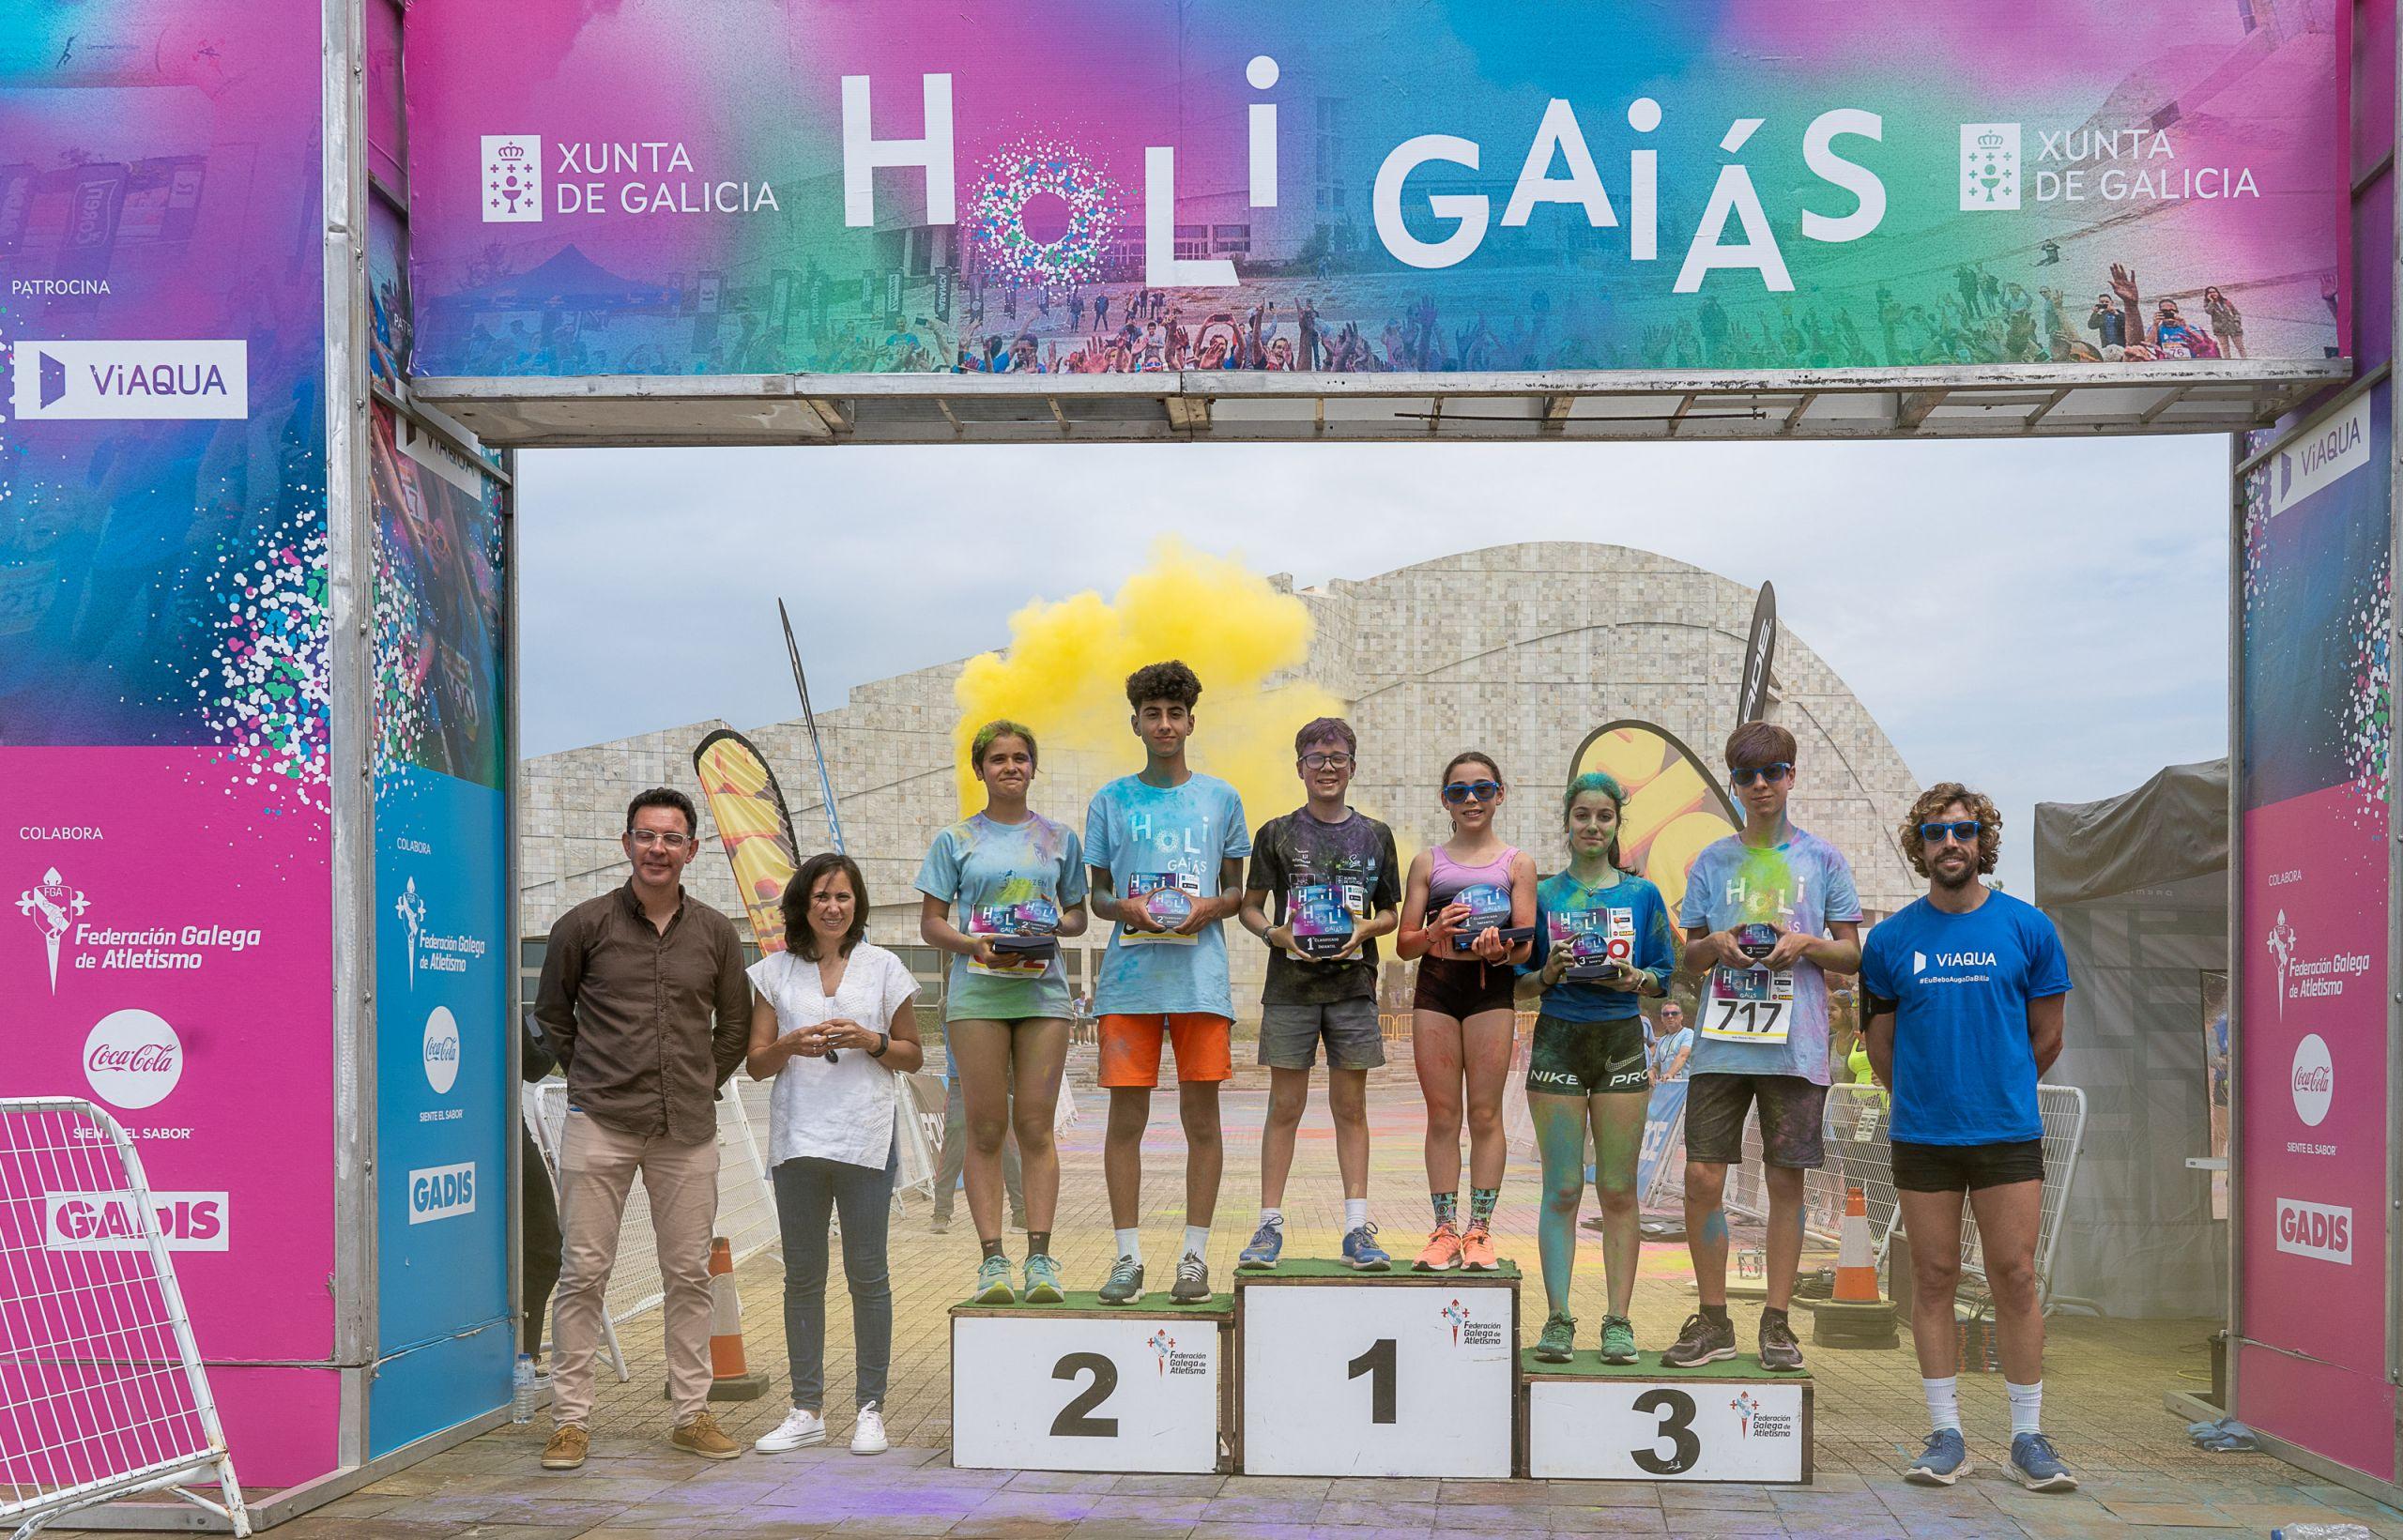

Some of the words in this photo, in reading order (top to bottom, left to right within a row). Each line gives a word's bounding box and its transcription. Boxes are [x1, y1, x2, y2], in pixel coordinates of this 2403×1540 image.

[2036, 128, 2174, 162] XUNTA
[557, 142, 694, 174] XUNTA
[2036, 169, 2085, 202] DE
[2101, 167, 2259, 200] GALICIA
[557, 185, 605, 215] DE
[621, 180, 780, 214] GALICIA
[12, 280, 111, 295] PATROCINA
[20, 827, 104, 840] COLABORA
[397, 837, 432, 855] COLABORA
[2268, 869, 2303, 887] COLABORA
[44, 887, 63, 898] FGA
[75, 923, 176, 946] Federación
[181, 924, 262, 952] Galega
[420, 929, 457, 952] Federación
[458, 935, 485, 958] Galega
[75, 953, 97, 969] de
[101, 949, 203, 969] Atletismo
[420, 955, 428, 969] de
[430, 953, 466, 972] Atletismo
[2289, 957, 2332, 977] Federación
[2333, 952, 2370, 976] Galega
[2288, 984, 2298, 999] de
[2300, 979, 2343, 998] Atletismo
[1717, 1000, 1783, 1033] 717
[1530, 1069, 1579, 1085] NIKE
[1609, 1069, 1648, 1087] PRO
[420, 1111, 438, 1122] SIENTE
[438, 1110, 446, 1121] EL
[2287, 1141, 2306, 1154] SIENTE
[2306, 1144, 2315, 1154] EL
[413, 1169, 473, 1213] GADIS
[2280, 1207, 2349, 1253] GADIS
[1463, 1320, 1501, 1330] Federación
[1463, 1329, 1493, 1338] Galega
[1463, 1336, 1501, 1345] Atletismo
[1170, 1350, 1206, 1360] Federación
[1170, 1359, 1199, 1368] Galega
[1170, 1366, 1206, 1375] Atletismo
[1348, 1338, 1397, 1424] 1
[1048, 1351, 1119, 1438] 2
[1753, 1412, 1791, 1422] Federación
[1753, 1421, 1783, 1431] Galega
[1630, 1388, 1701, 1475] 3
[1753, 1428, 1791, 1438] Atletismo
